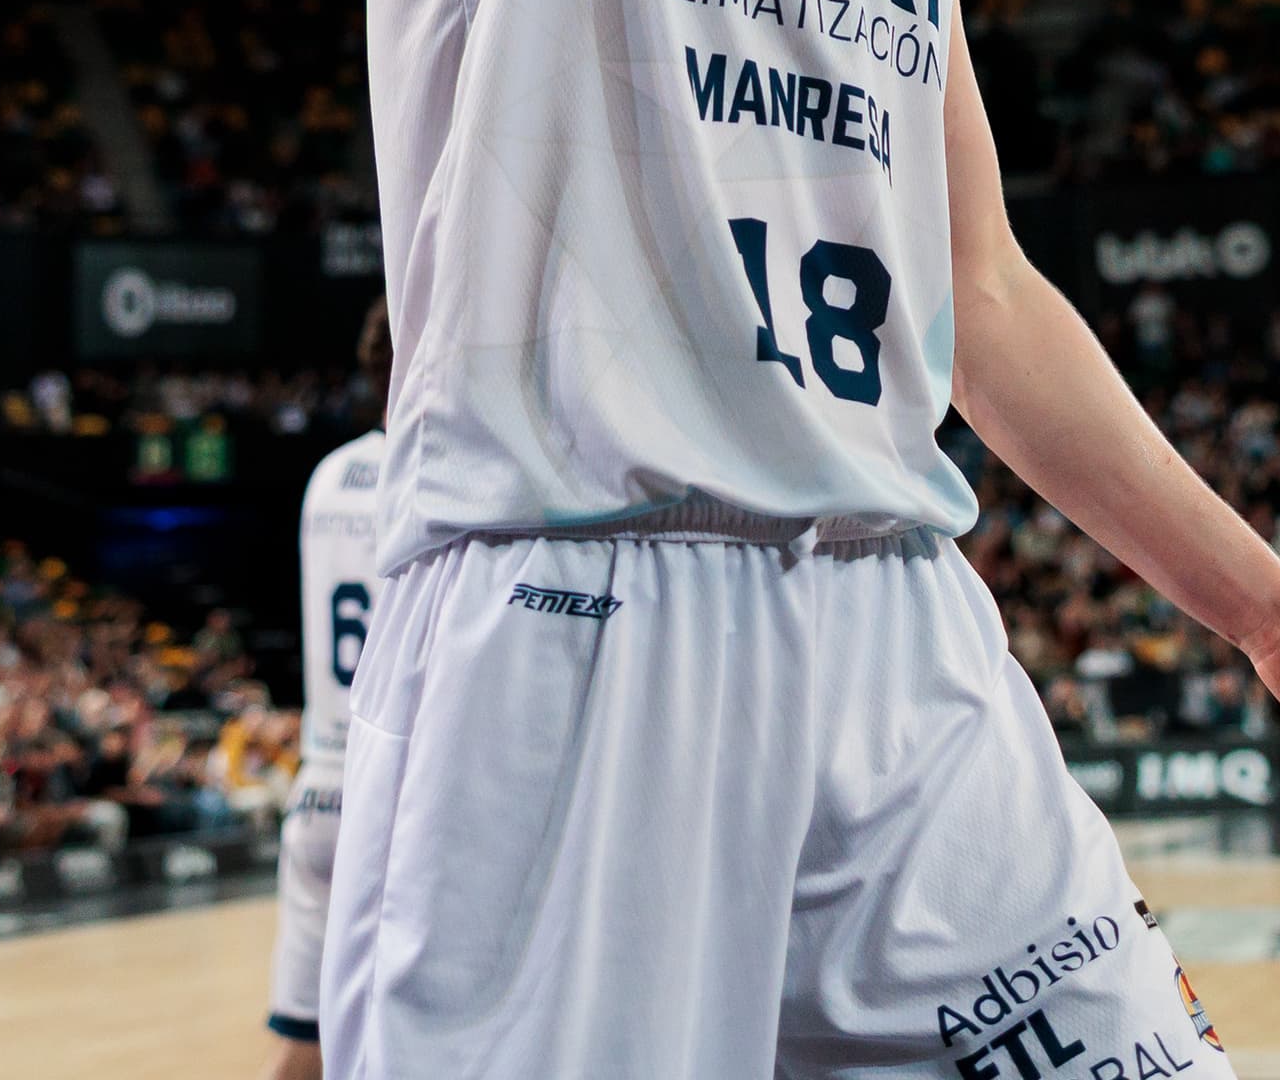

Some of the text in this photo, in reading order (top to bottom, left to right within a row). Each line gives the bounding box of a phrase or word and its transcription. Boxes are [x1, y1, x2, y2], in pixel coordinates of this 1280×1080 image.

[685, 46, 892, 186] MANRESA
[728, 217, 892, 407] 18
[1138, 750, 1272, 805] IMQ
[937, 915, 1120, 1047] Adbisio
